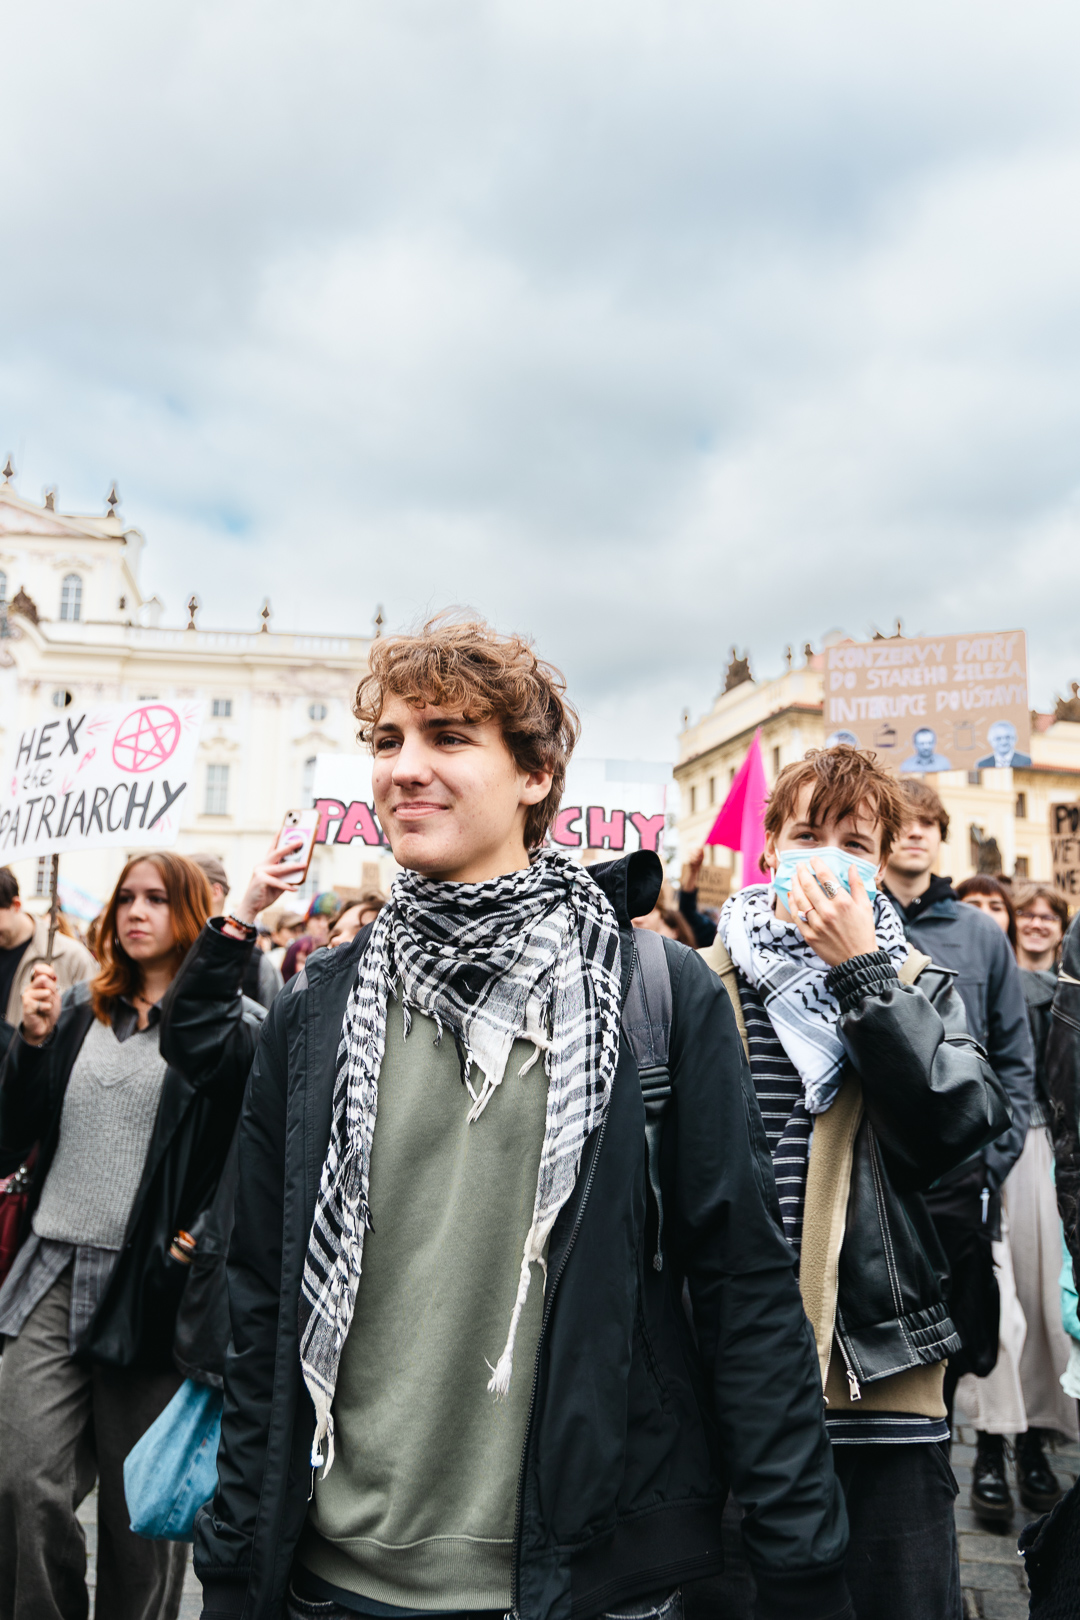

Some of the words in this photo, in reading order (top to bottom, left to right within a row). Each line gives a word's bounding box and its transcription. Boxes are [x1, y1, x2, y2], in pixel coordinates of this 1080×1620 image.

[828, 643, 945, 670] KONZERVY
[830, 670, 857, 691] DO
[866, 662, 948, 690] STARÉHO
[830, 693, 927, 723] INTERUPCE
[15, 714, 87, 770] HEX
[22, 764, 54, 790] the
[0, 780, 188, 850] PATRIARCHY
